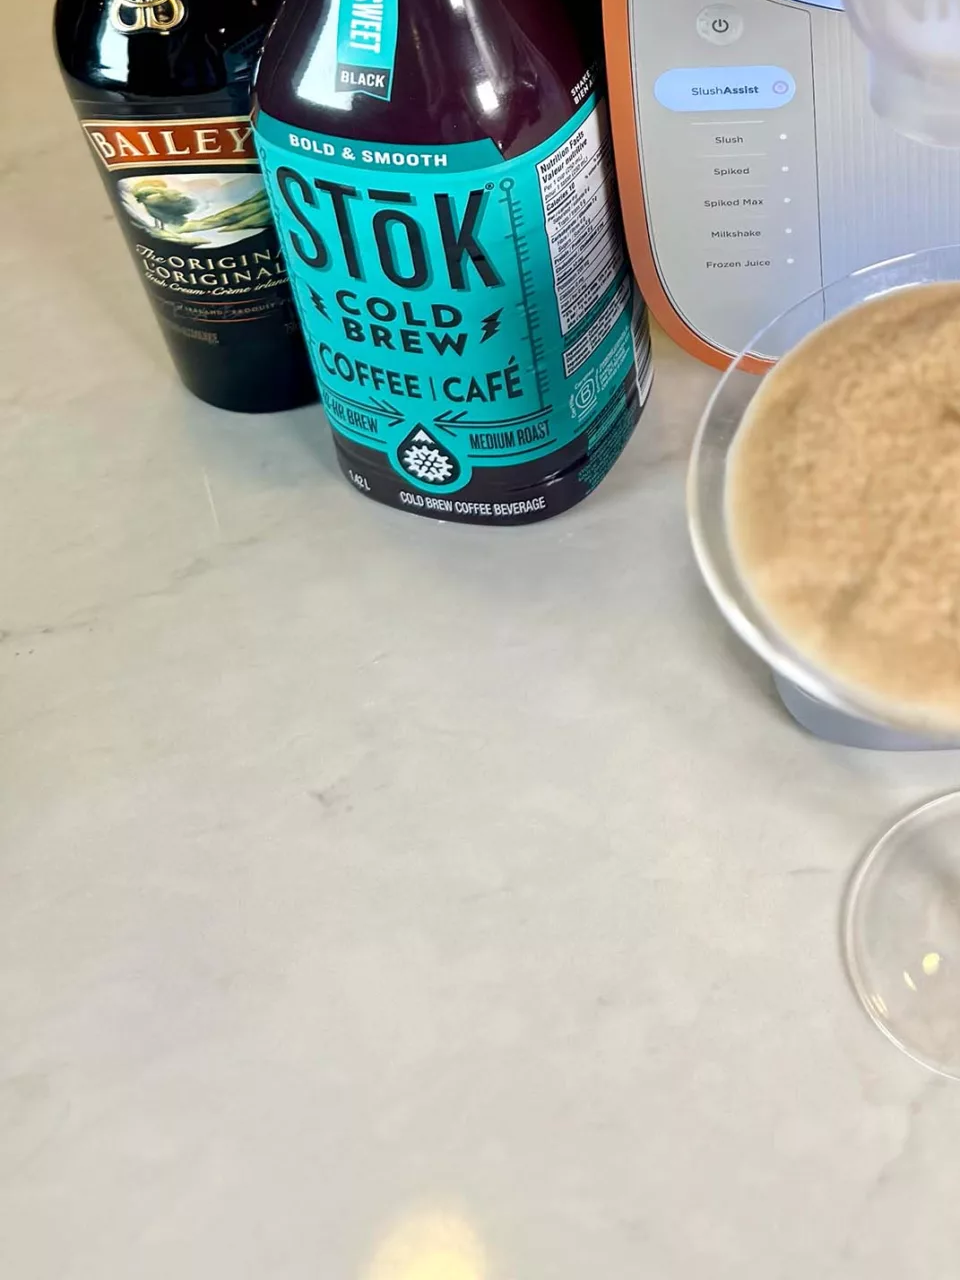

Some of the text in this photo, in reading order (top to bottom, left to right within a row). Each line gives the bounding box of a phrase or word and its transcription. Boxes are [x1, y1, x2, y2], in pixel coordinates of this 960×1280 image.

[340, 70, 386, 88] BLACK
[570, 69, 590, 97] SHAKE
[573, 85, 590, 105] BIEN
[691, 86, 760, 96] SlushAssist
[288, 133, 448, 168] BOLD & SMOOTH
[714, 136, 744, 145] Slush
[540, 146, 570, 175] Nutrition
[569, 130, 585, 150] Facts
[713, 168, 750, 177] Spiked
[703, 198, 764, 208] Spiked Max
[711, 230, 762, 239] Milkshake
[136, 244, 166, 265] The
[706, 261, 742, 269] Frozen
[169, 283, 206, 296] Cream
[209, 285, 252, 297] Crème
[335, 289, 463, 329] COLD
[341, 316, 469, 357] BREW
[318, 341, 423, 399] COFFEE
[442, 355, 524, 404] CAFÉ
[346, 408, 379, 434] BREW
[469, 419, 551, 450] MEDIUM ROAST
[400, 491, 547, 516] COLD BREW COFFEE BEVERAGE
